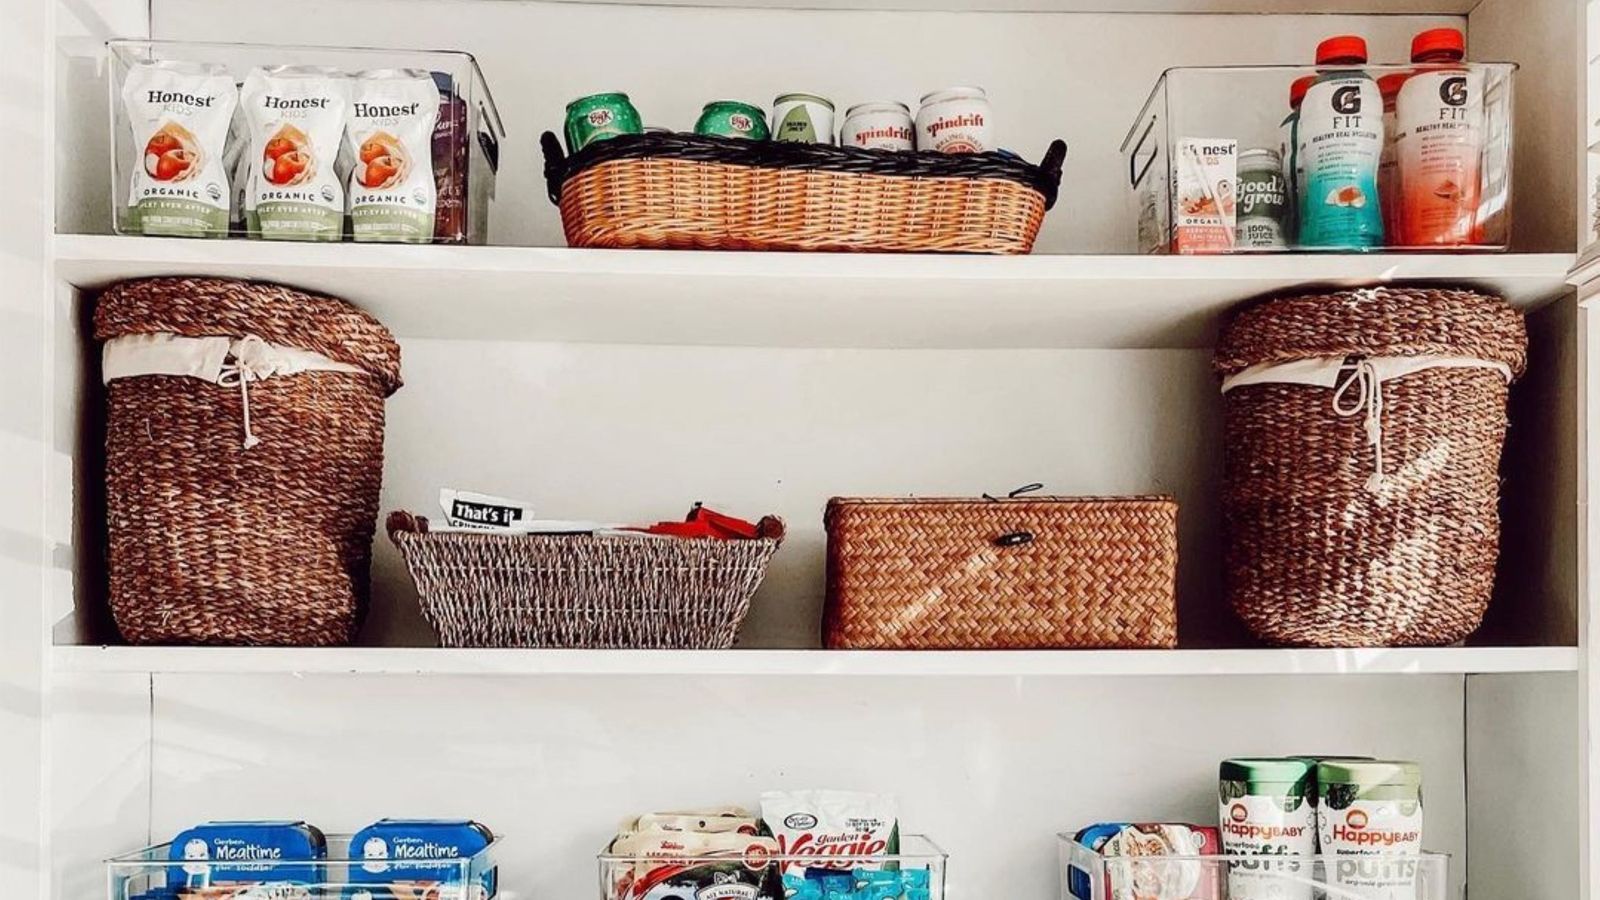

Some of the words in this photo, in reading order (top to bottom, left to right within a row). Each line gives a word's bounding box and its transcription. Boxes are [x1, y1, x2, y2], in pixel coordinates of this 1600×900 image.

[148, 90, 214, 107] Honest
[1331, 85, 1361, 114] G
[1439, 77, 1468, 106] G
[163, 104, 193, 116] KIDS
[265, 96, 326, 109] Honest
[354, 103, 417, 118] Honest
[1440, 107, 1467, 120] FIT
[926, 114, 984, 138] spindrift
[1333, 116, 1362, 129] FIT
[856, 126, 913, 145] spindrift
[144, 187, 199, 198] ORGANIC
[261, 192, 315, 202] ORGANIC
[355, 195, 406, 204] ORGANIC
[1243, 193, 1285, 213] grow
[455, 503, 499, 522] That's
[216, 844, 281, 860] Mealtime
[395, 842, 459, 858] Mealtime
[777, 832, 886, 873] Veggie
